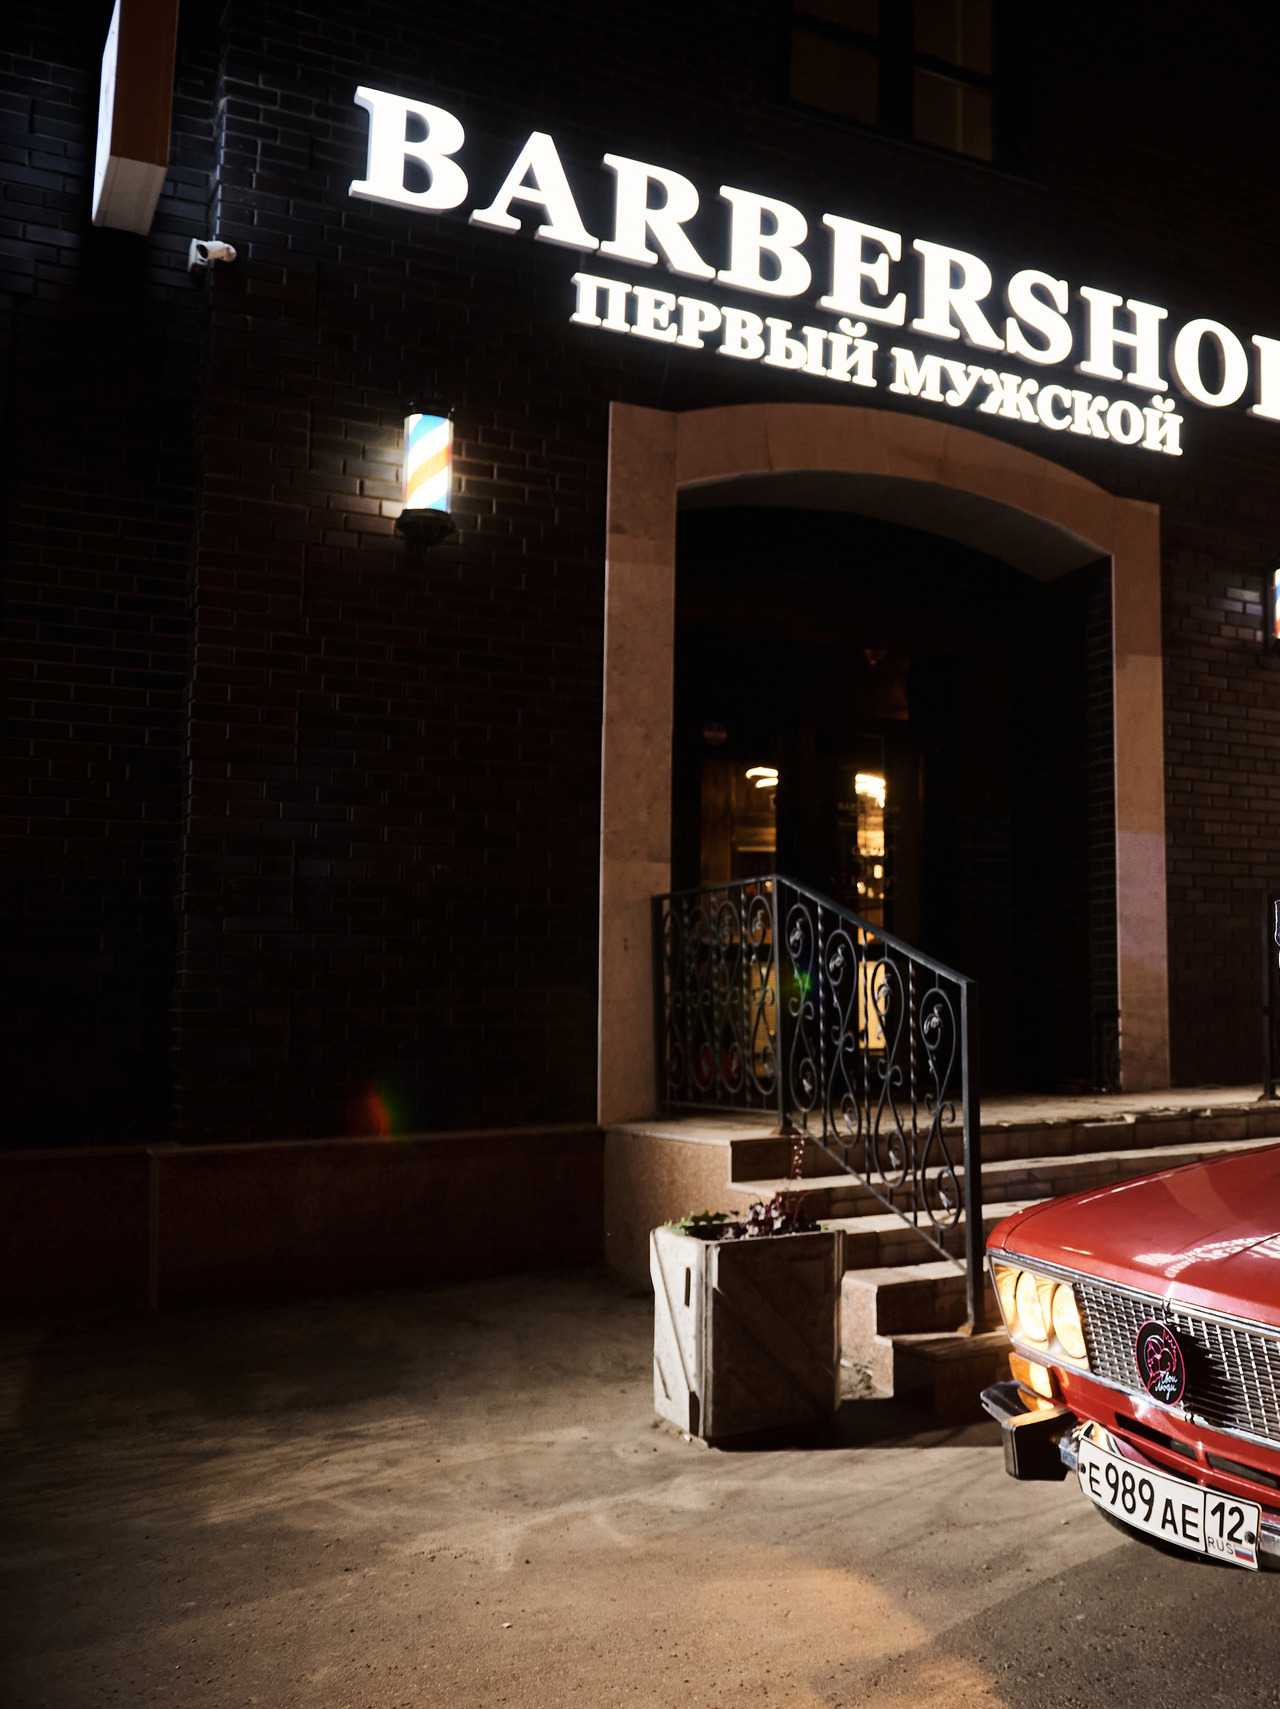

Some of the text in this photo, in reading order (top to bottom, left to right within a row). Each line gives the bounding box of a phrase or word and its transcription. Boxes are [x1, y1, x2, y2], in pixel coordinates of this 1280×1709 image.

[569, 272, 1184, 456] ПЕРВЫЙ МУЖСКОЙ
[1211, 1501, 1245, 1545] 12
[1207, 1536, 1234, 1555] RUS
